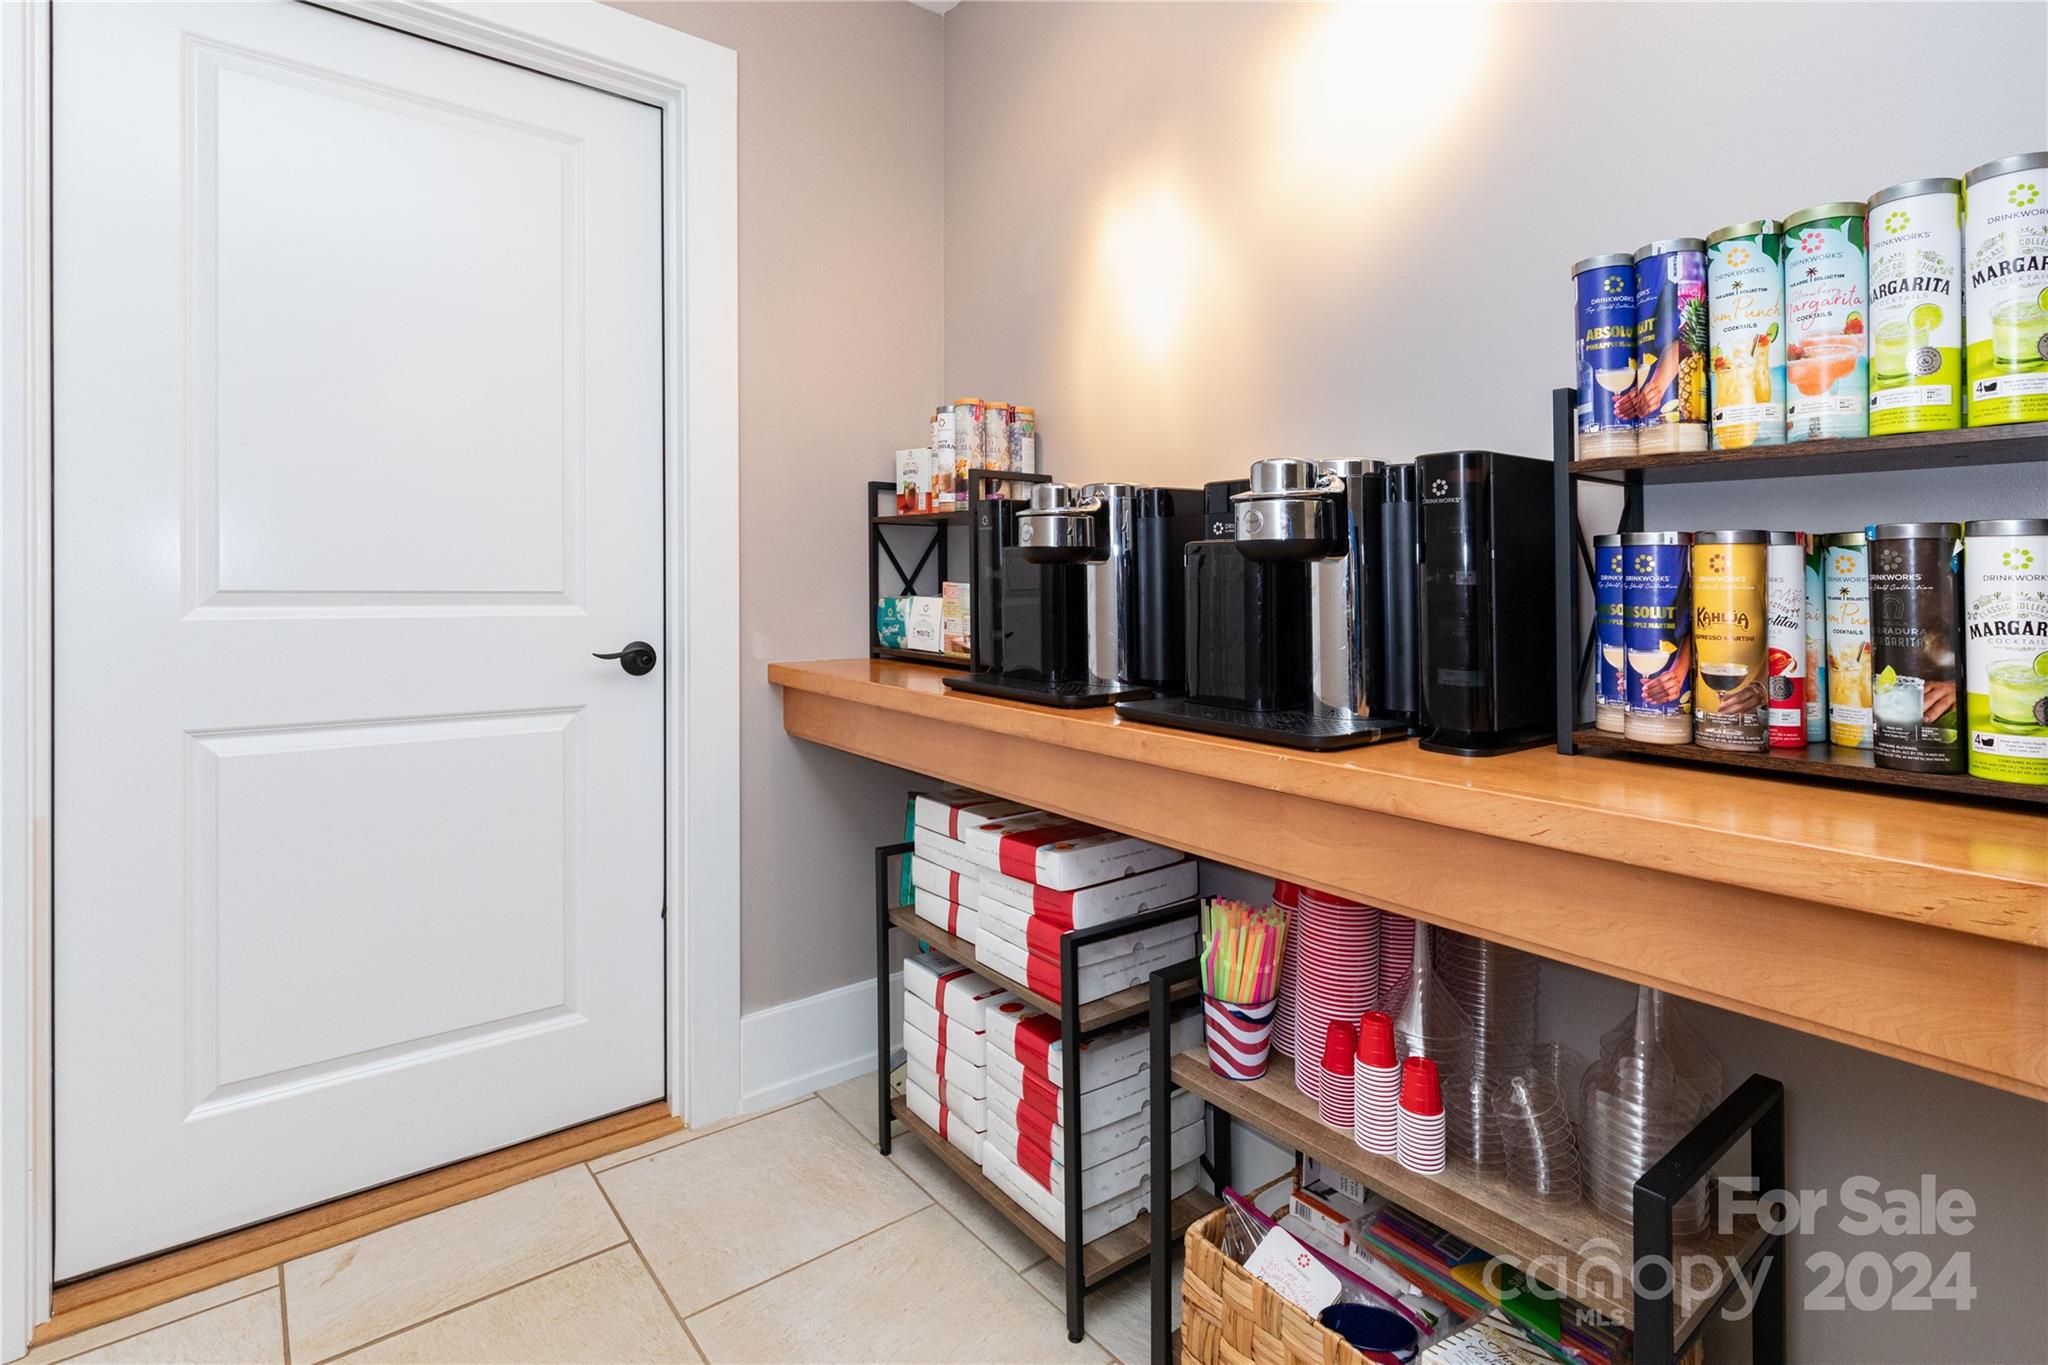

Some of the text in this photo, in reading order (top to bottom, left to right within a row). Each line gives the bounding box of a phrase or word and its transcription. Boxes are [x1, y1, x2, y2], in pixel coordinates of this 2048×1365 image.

[1789, 251, 1843, 269] DRINKWORKS
[1714, 267, 1765, 282] DRINKWORKS
[1976, 382, 1983, 393] 4
[1974, 734, 1981, 745] 4
